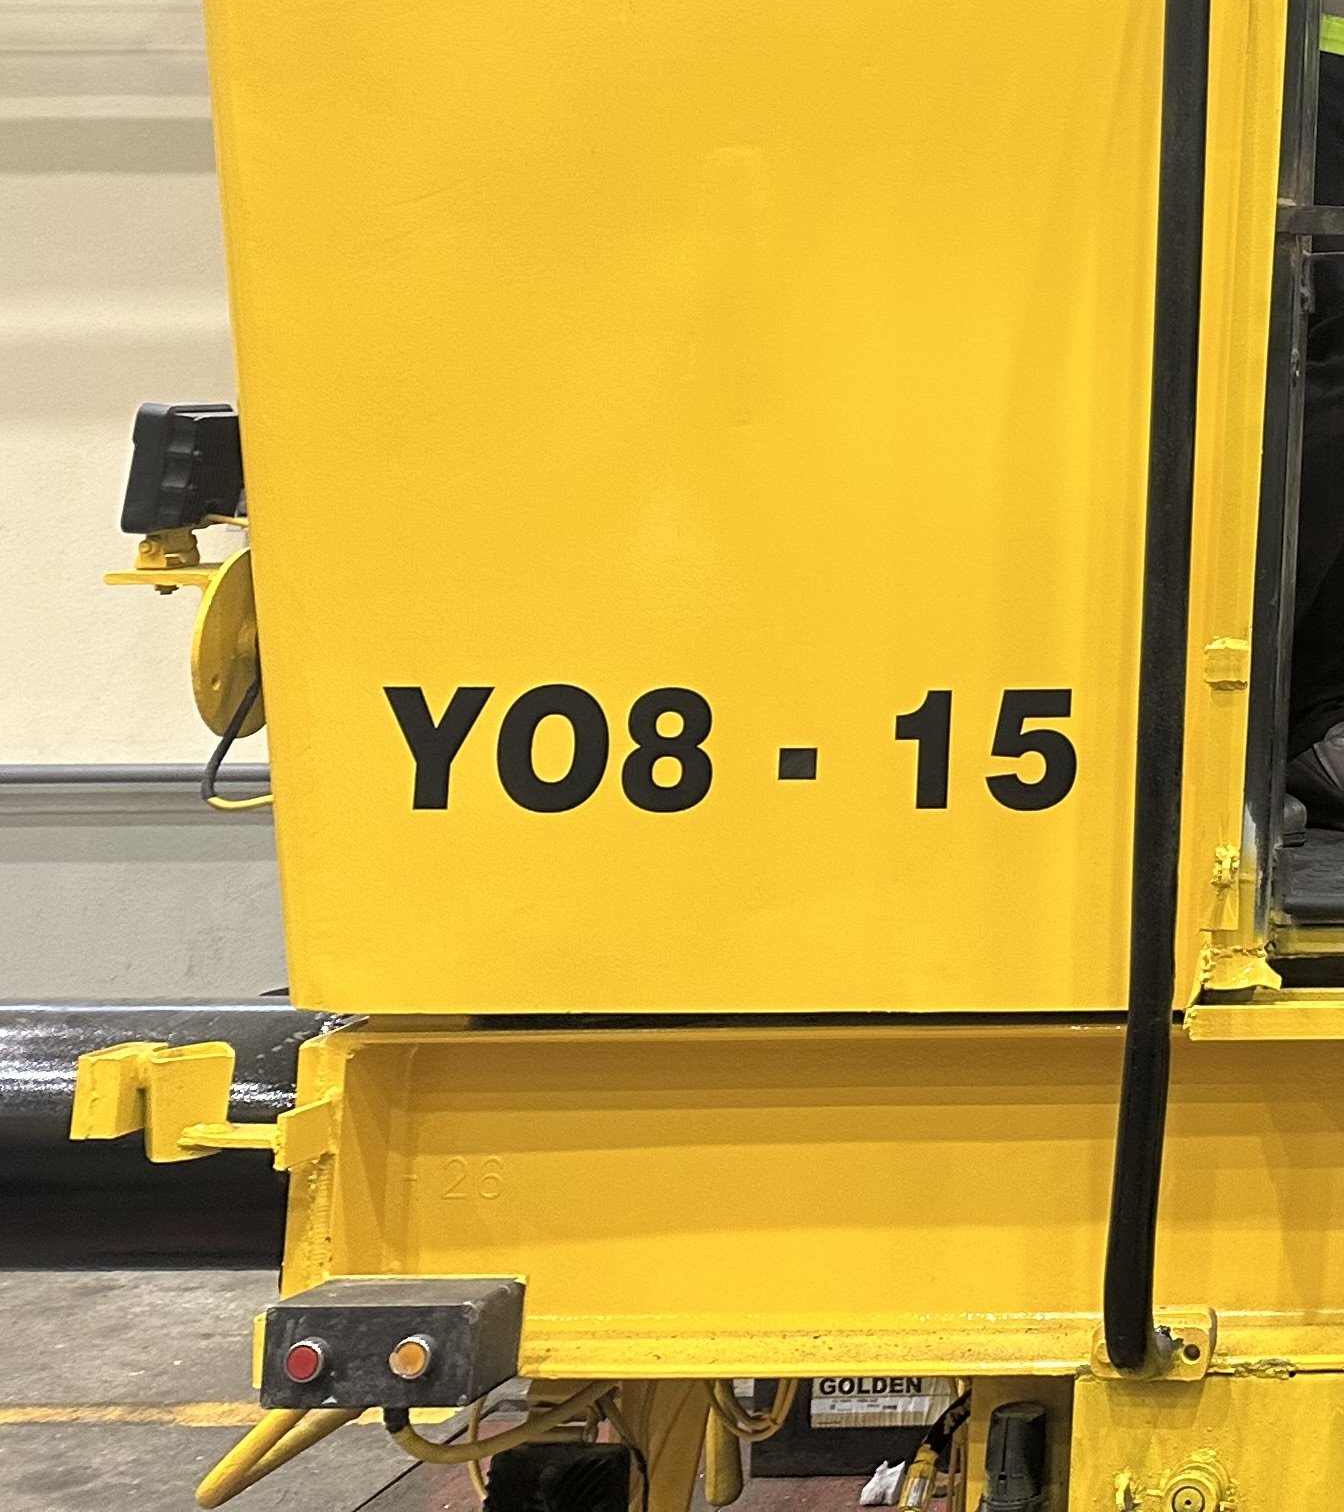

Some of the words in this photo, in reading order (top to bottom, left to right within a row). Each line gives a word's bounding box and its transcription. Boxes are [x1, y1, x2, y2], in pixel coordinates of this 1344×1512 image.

[895, 688, 1077, 812] 15
[440, 1154, 505, 1201] 26
[819, 1377, 922, 1396] GOLDEN
